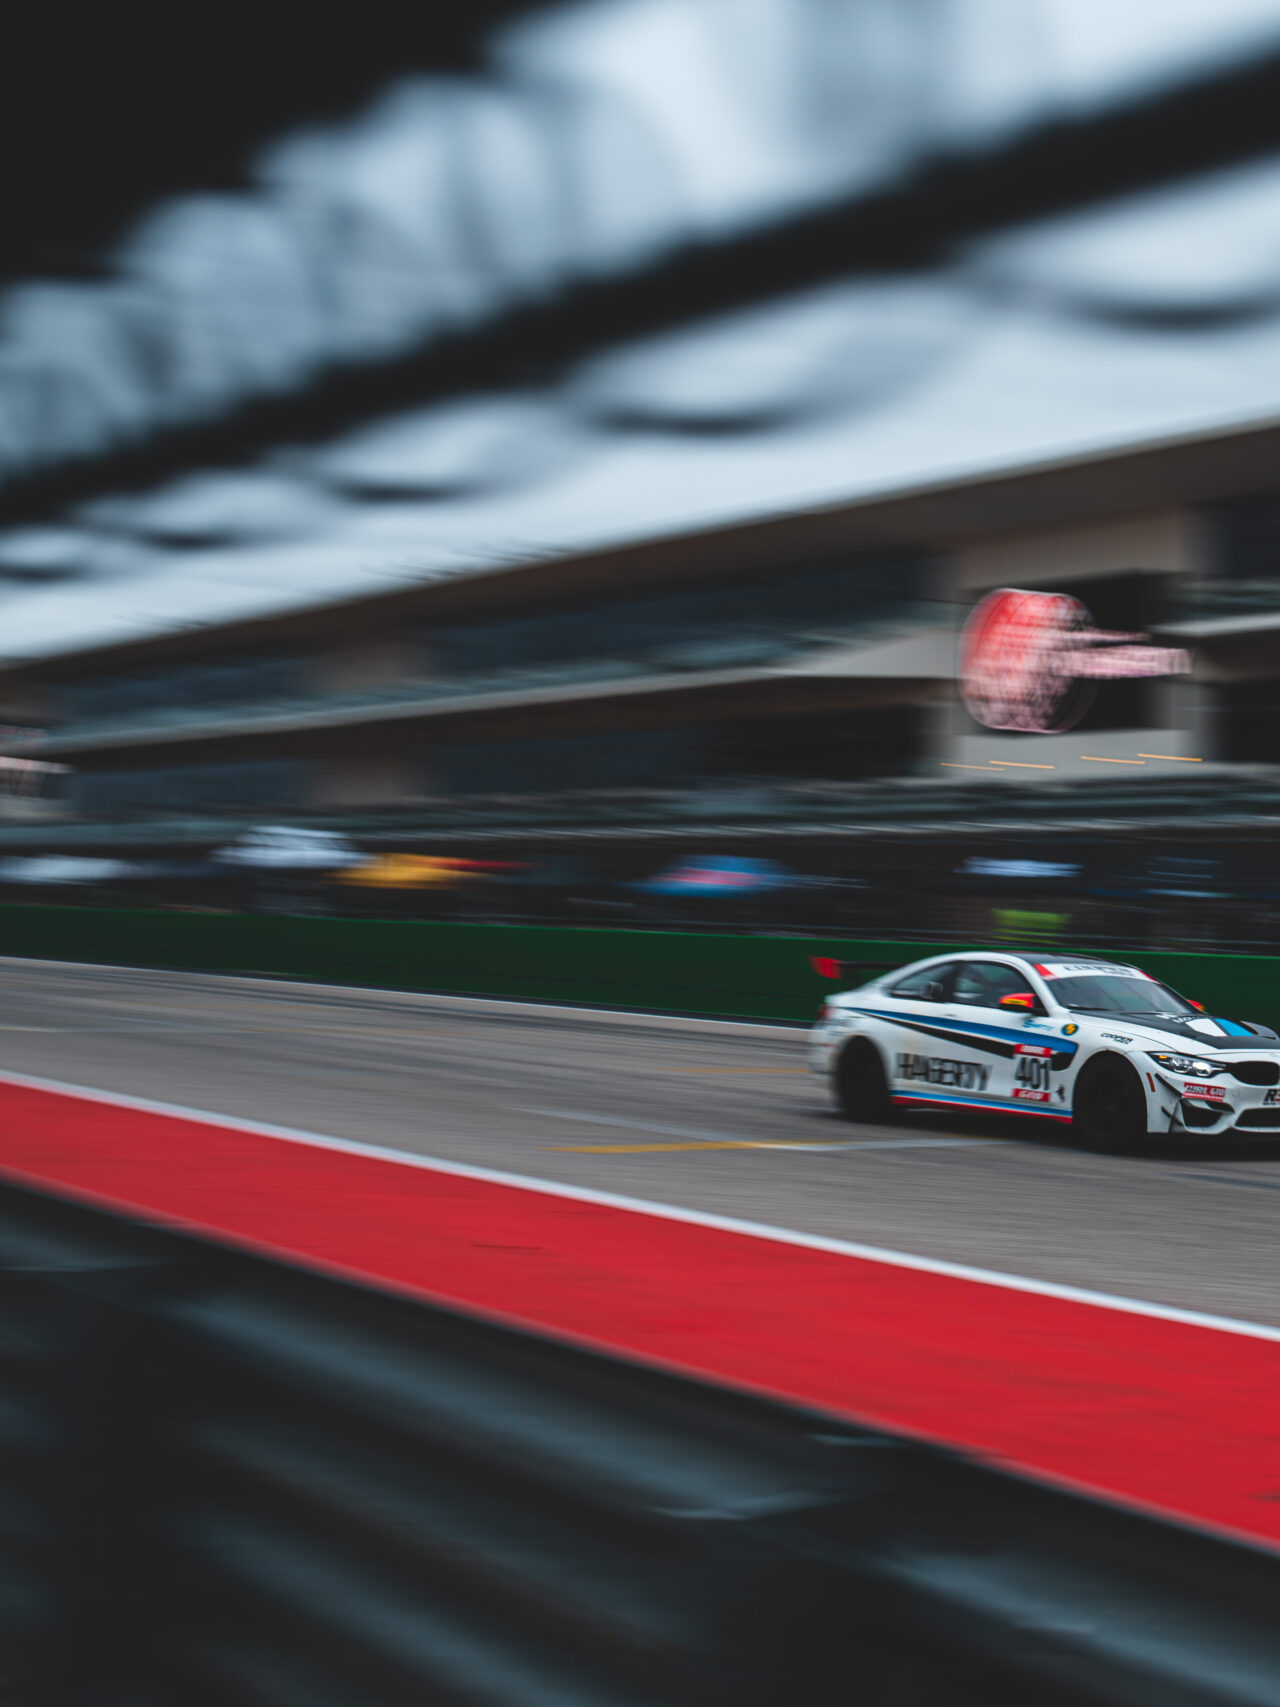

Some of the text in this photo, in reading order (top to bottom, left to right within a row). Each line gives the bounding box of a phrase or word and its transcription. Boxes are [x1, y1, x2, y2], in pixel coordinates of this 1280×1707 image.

[1100, 1032, 1134, 1042] COOPER
[895, 1052, 994, 1091] HAGERTY
[1014, 1057, 1051, 1091] 401
